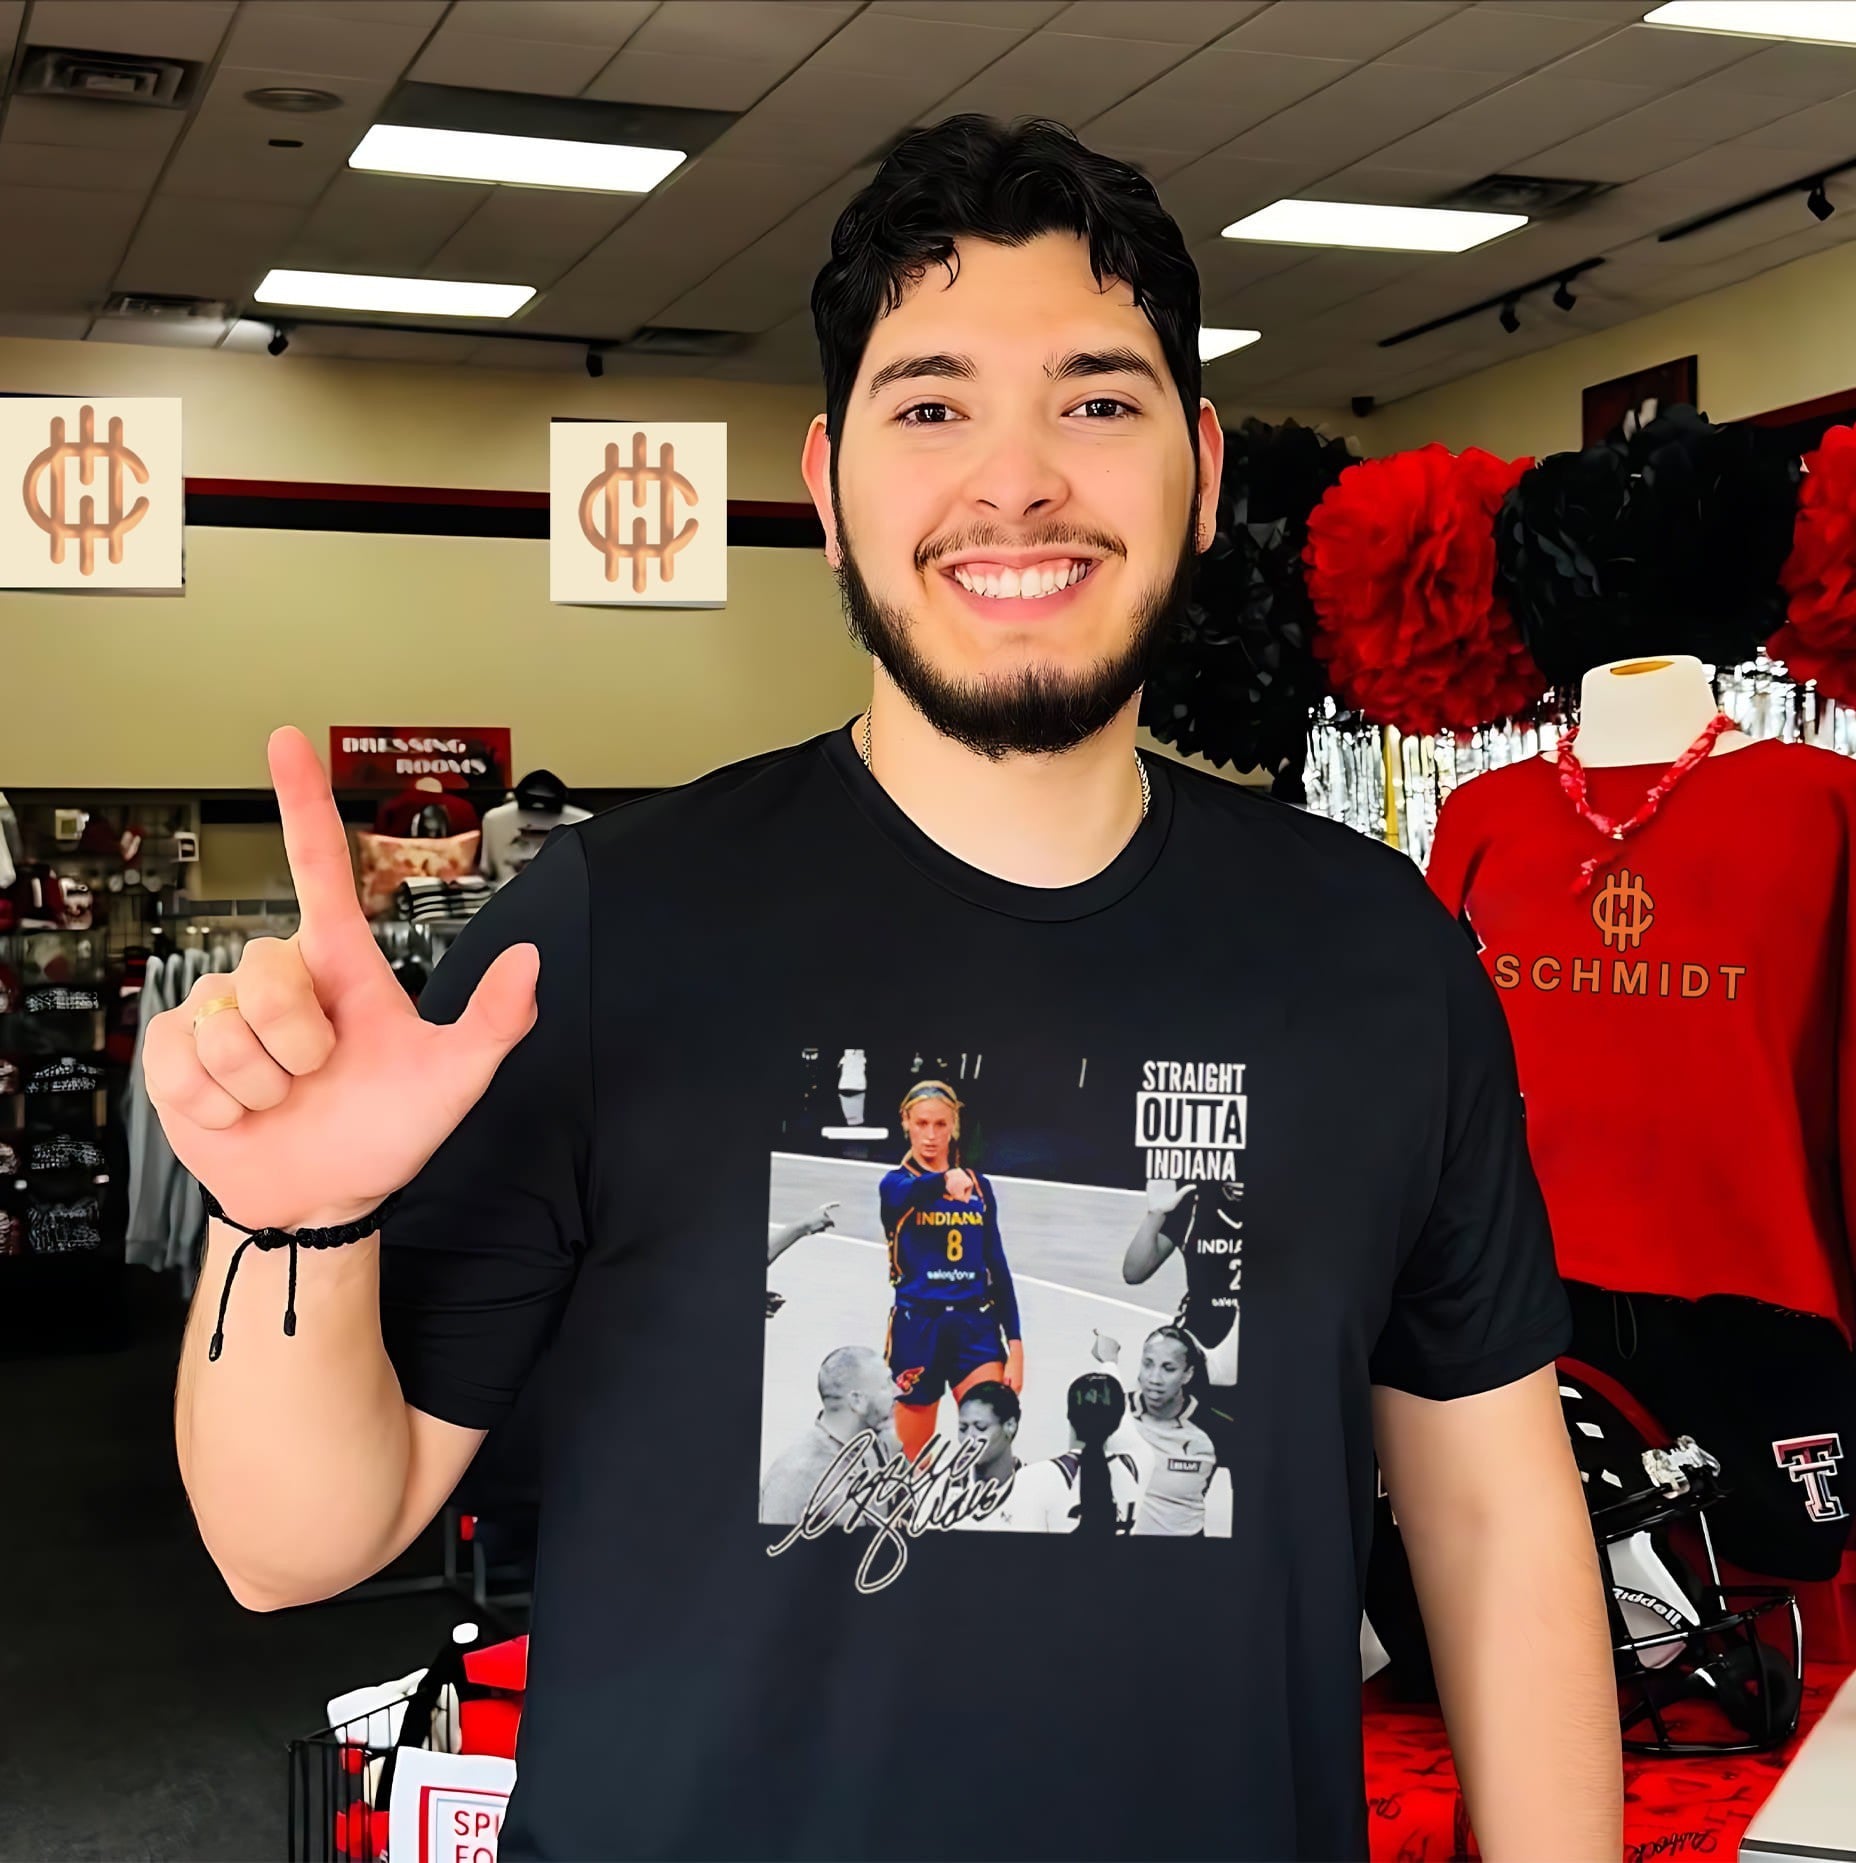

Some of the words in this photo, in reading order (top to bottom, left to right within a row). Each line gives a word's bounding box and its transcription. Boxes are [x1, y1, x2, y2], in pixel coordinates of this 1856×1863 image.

[342, 738, 466, 754] DRESSING
[396, 758, 487, 774] ROOMS
[1494, 954, 1746, 1000] SCHMIDT
[1142, 1060, 1246, 1094] STRAIGHT
[1143, 1097, 1243, 1144] OUTTA
[1146, 1148, 1236, 1181] INDIANA
[916, 1211, 983, 1226] INDIANA
[947, 1229, 963, 1262] 8
